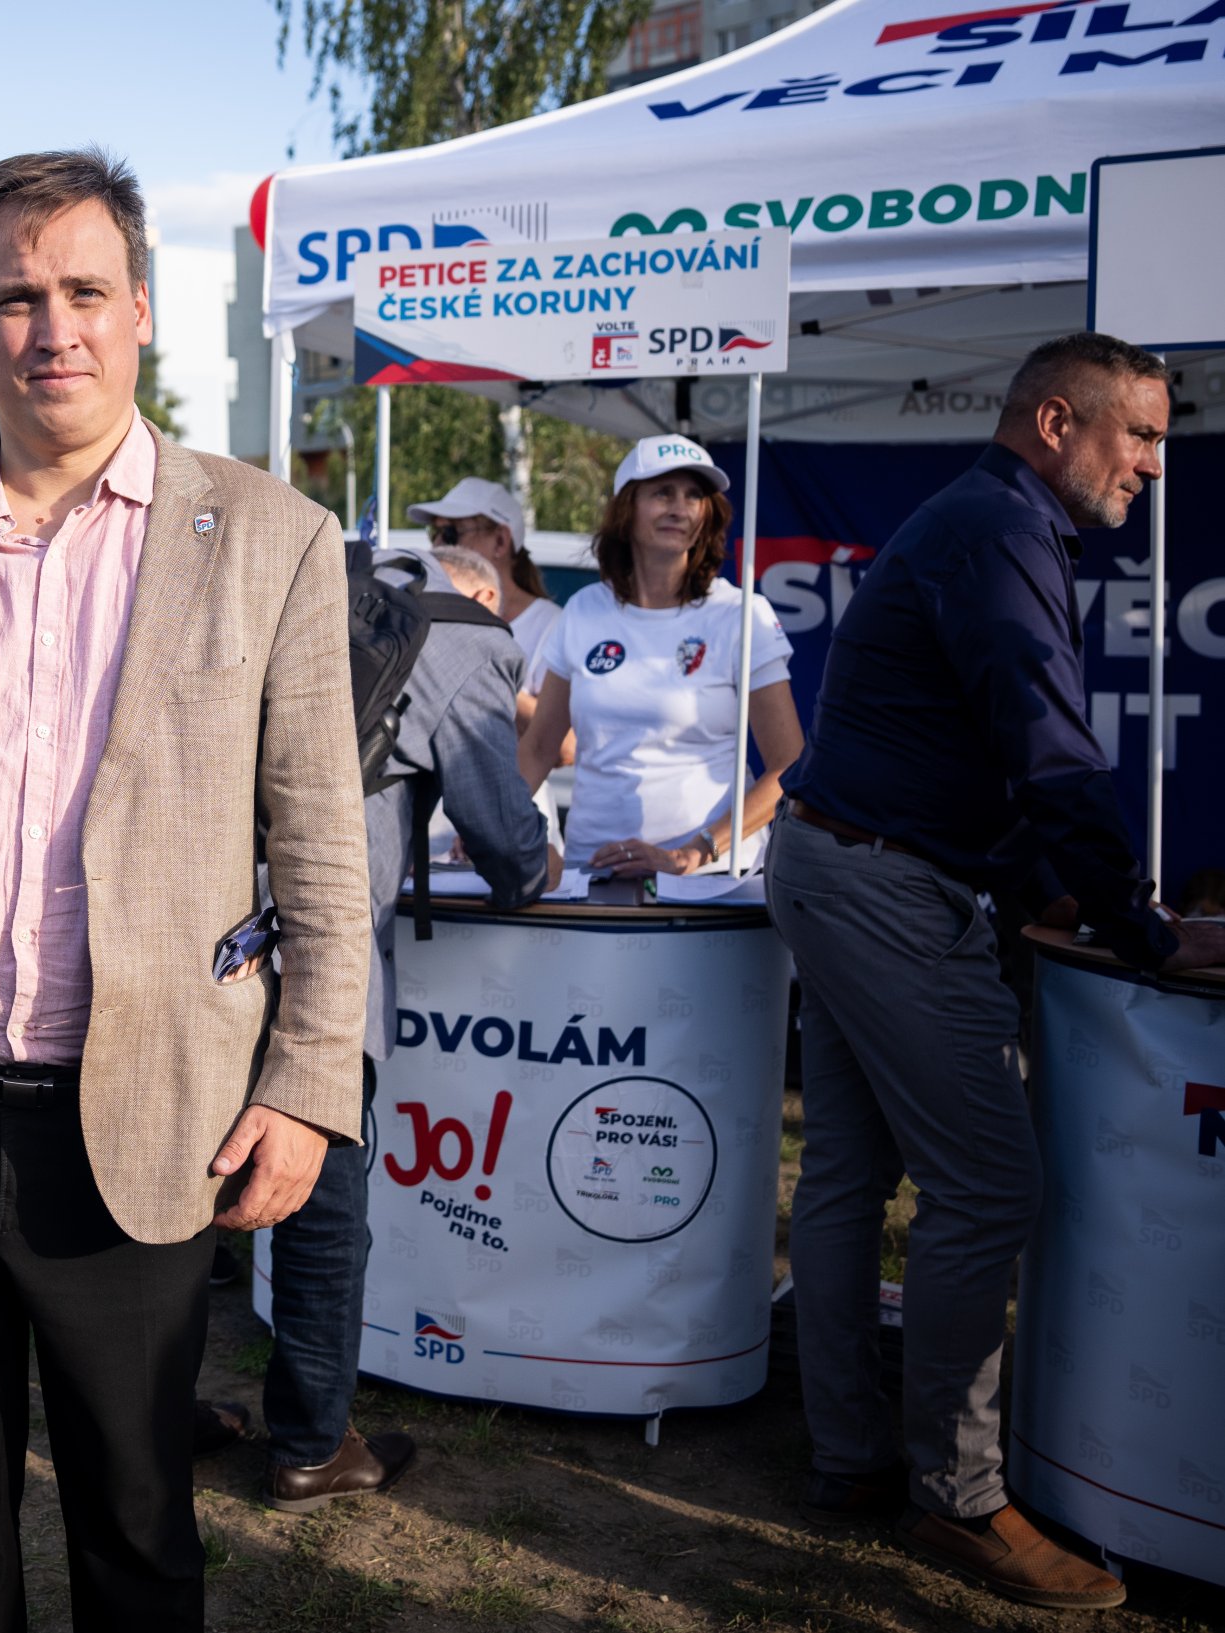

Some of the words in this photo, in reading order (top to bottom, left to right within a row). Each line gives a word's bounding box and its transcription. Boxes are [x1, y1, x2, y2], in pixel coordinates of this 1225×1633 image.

[647, 60, 1005, 121] VĚCI
[1058, 38, 1225, 76] M
[379, 260, 487, 289] PETICE
[497, 257, 542, 282] ZA
[553, 236, 762, 280] ZACHOVÁNÍ
[378, 288, 482, 321] ČESKÉ
[493, 286, 636, 317] KORUNY
[596, 321, 635, 331] VOLTE
[648, 327, 713, 354] SPD
[657, 444, 702, 461] PRO
[197, 521, 213, 531] SPD
[589, 655, 615, 670] SPD
[598, 1113, 678, 1129] SPOJENI.
[596, 1130, 633, 1144] PRO
[638, 1131, 678, 1147] VÁS!
[592, 1166, 613, 1176] SPD
[654, 1195, 680, 1207] PRO
[419, 1190, 503, 1230] Pojďme
[449, 1221, 476, 1240] na
[481, 1231, 509, 1252] to.
[414, 1336, 465, 1364] SPD
